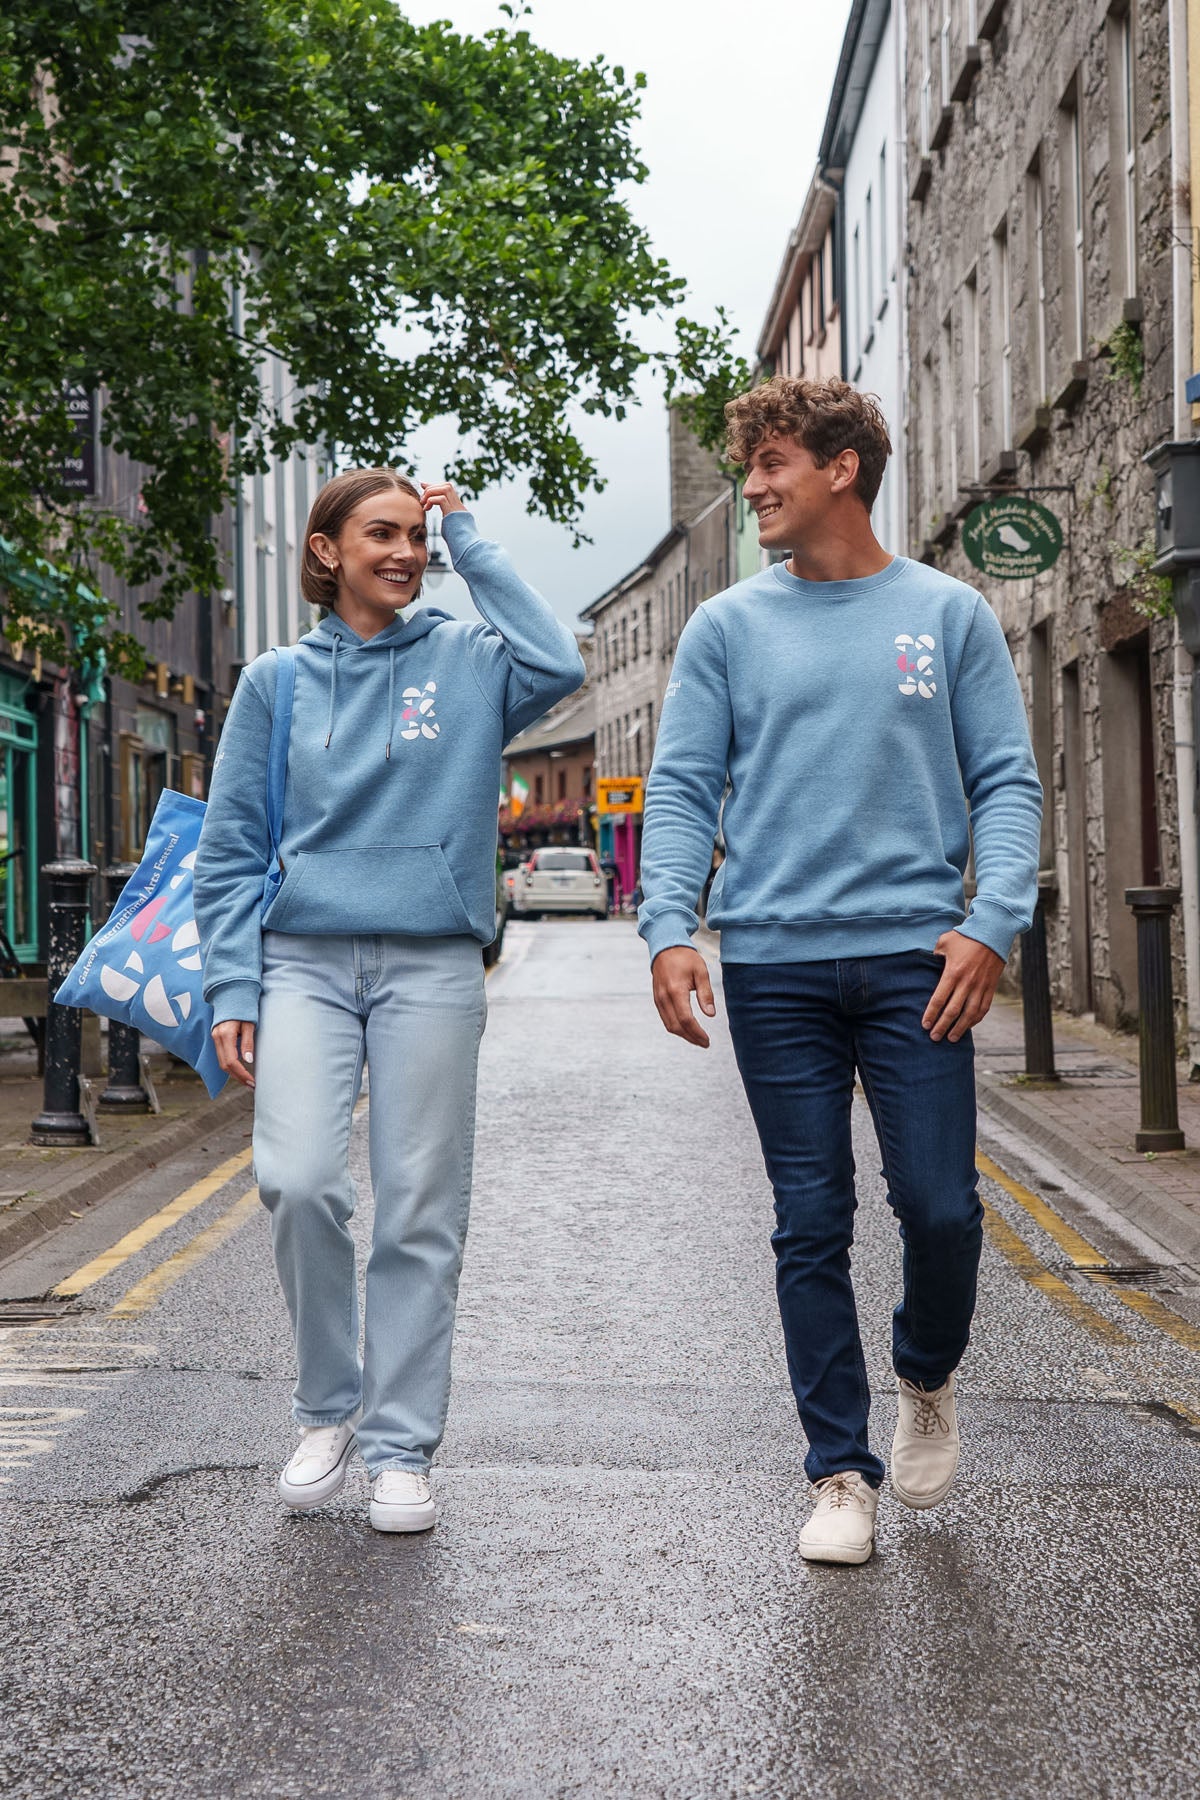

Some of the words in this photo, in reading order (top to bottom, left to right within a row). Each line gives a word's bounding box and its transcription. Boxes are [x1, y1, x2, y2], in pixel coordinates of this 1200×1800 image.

[982, 552, 1043, 567] Chiropodist
[985, 564, 1037, 576] Podiatrist
[78, 949, 98, 986] Galway
[95, 892, 149, 948] International
[144, 873, 161, 898] Arts
[154, 833, 179, 871] Festival
